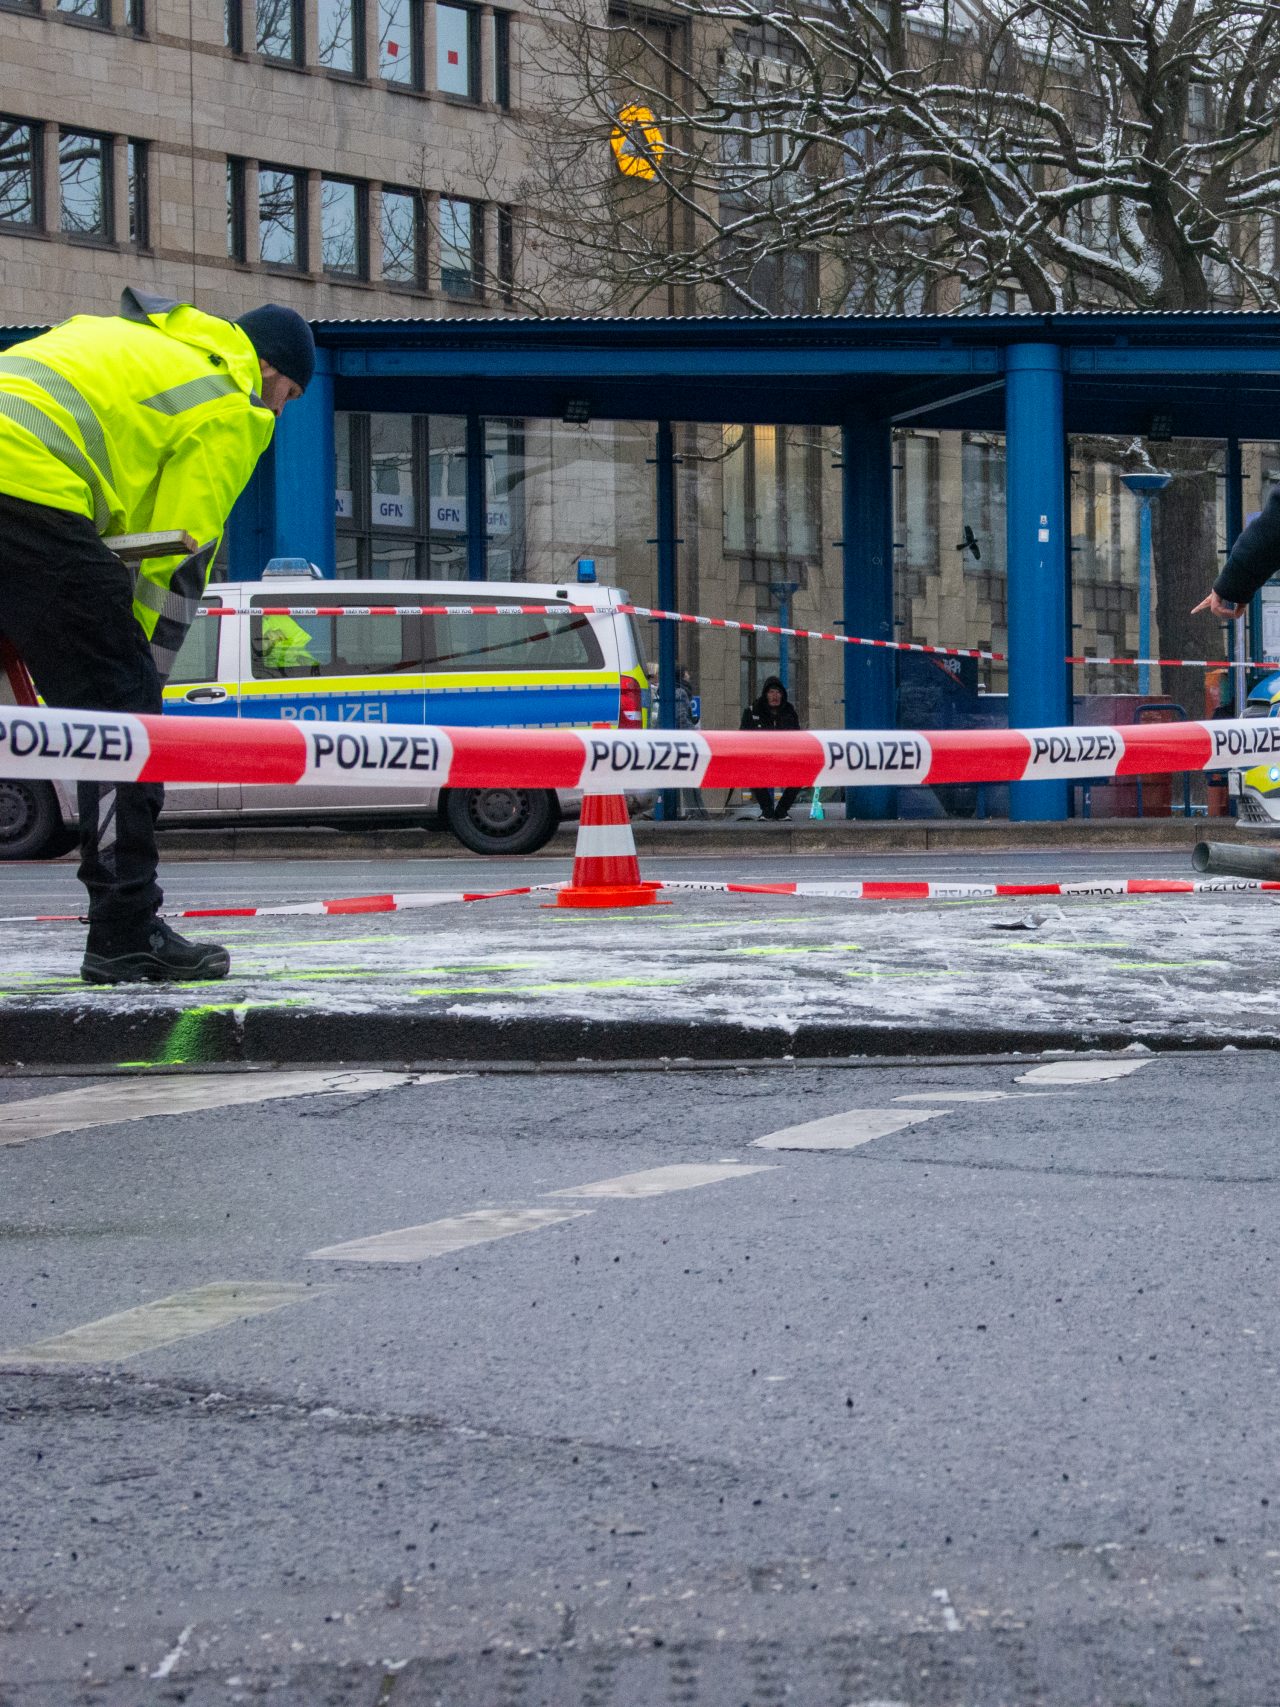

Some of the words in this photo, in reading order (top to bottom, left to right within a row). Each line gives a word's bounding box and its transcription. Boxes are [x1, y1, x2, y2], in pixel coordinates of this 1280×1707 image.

[380, 502, 403, 518] GFN
[437, 508, 460, 523] GFN
[312, 733, 439, 771] POLIZEI
[590, 740, 699, 771] POLIZEI
[828, 740, 922, 771] POLIZEI
[1033, 735, 1117, 764] POLIZEI
